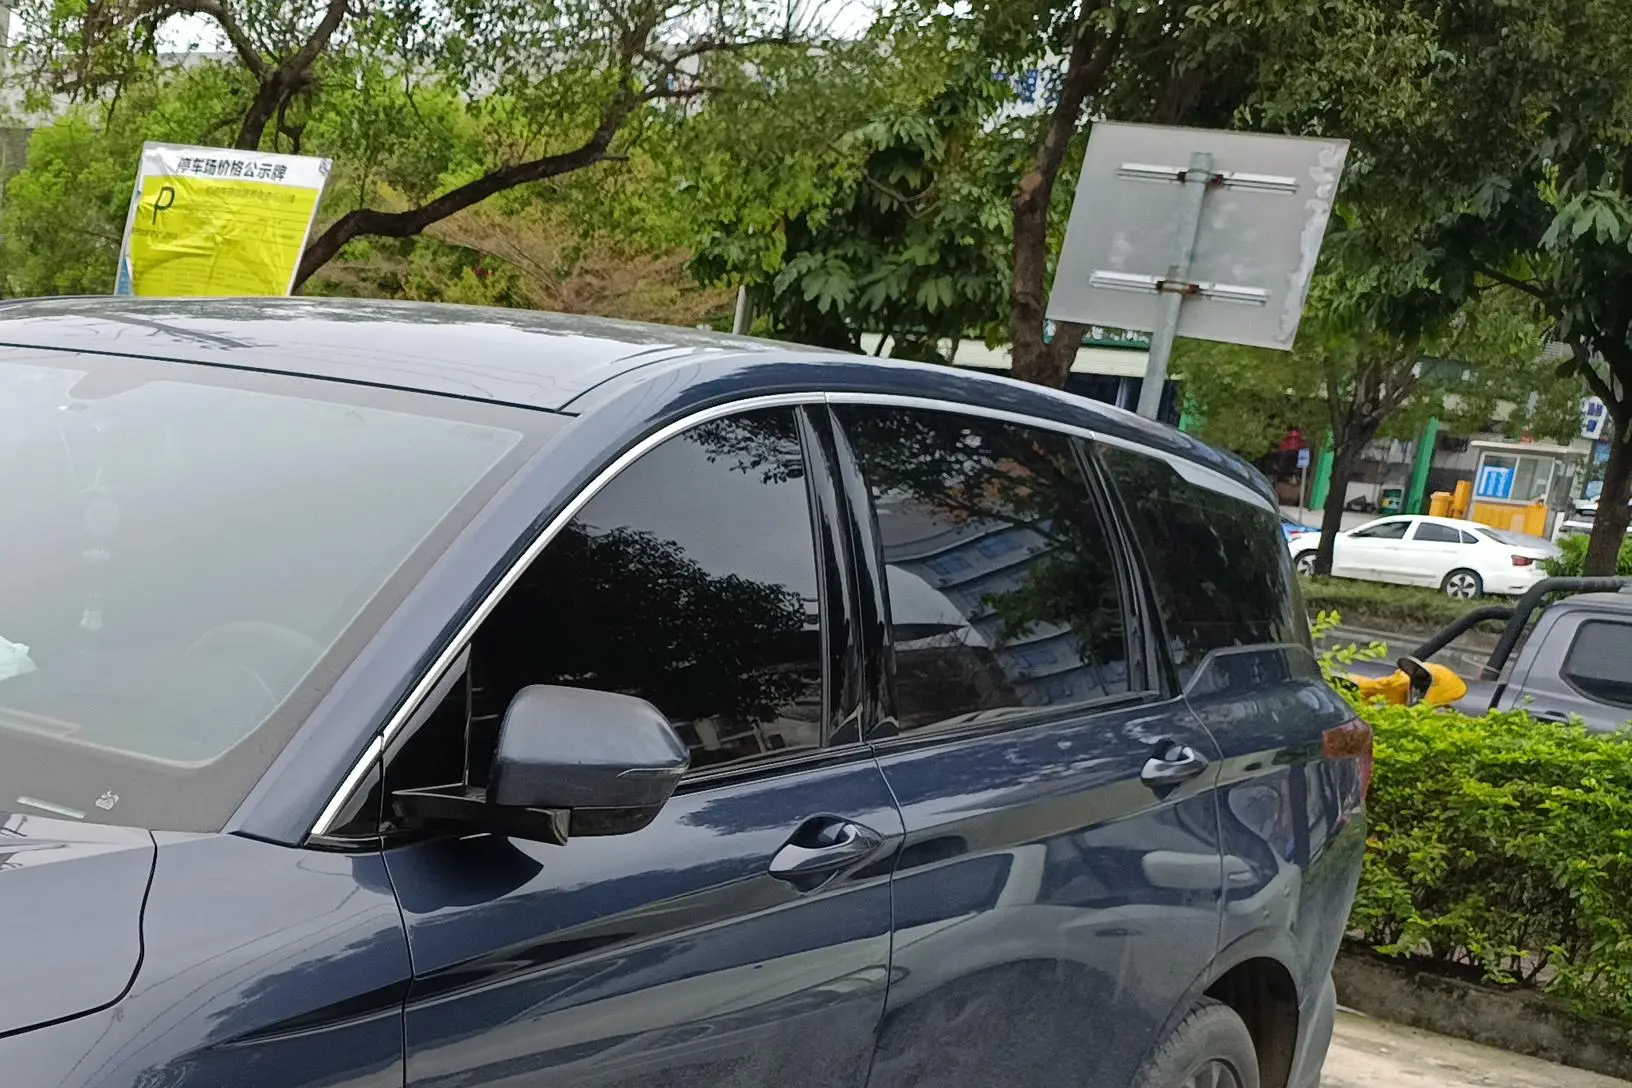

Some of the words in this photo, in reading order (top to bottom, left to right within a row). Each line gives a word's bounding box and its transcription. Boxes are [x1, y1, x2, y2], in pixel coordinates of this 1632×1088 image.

[176, 157, 288, 181] 停车场价格公示牌
[152, 186, 176, 225] P
